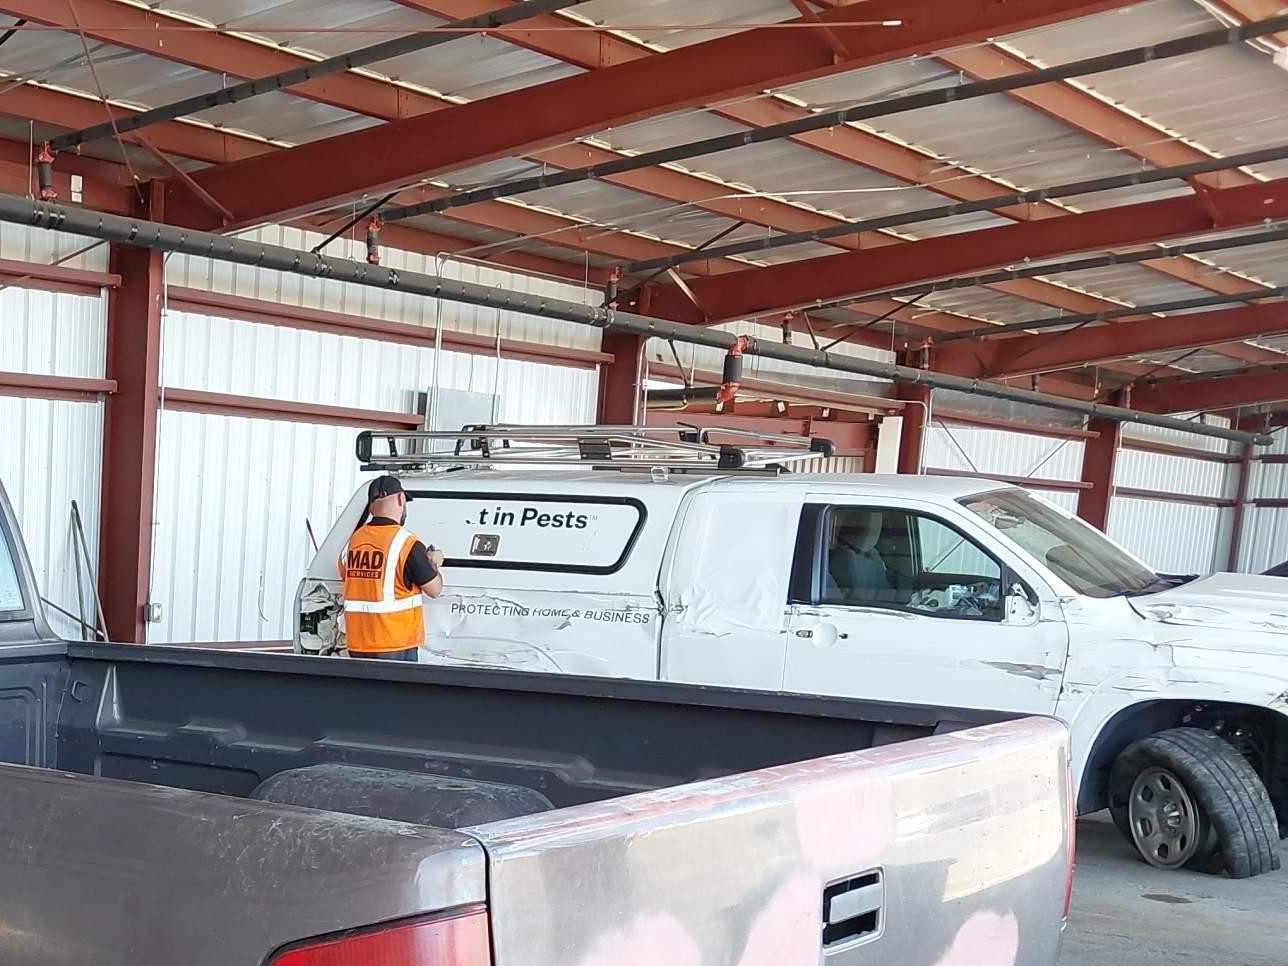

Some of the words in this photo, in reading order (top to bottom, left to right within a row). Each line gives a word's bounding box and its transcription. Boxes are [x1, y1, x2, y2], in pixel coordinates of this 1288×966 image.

[492, 506, 515, 526] in
[520, 507, 588, 529] Pests
[347, 550, 384, 570] MAD
[451, 603, 530, 616] PROTECTING
[572, 609, 581, 618] &
[584, 610, 650, 624] BUSINESS
